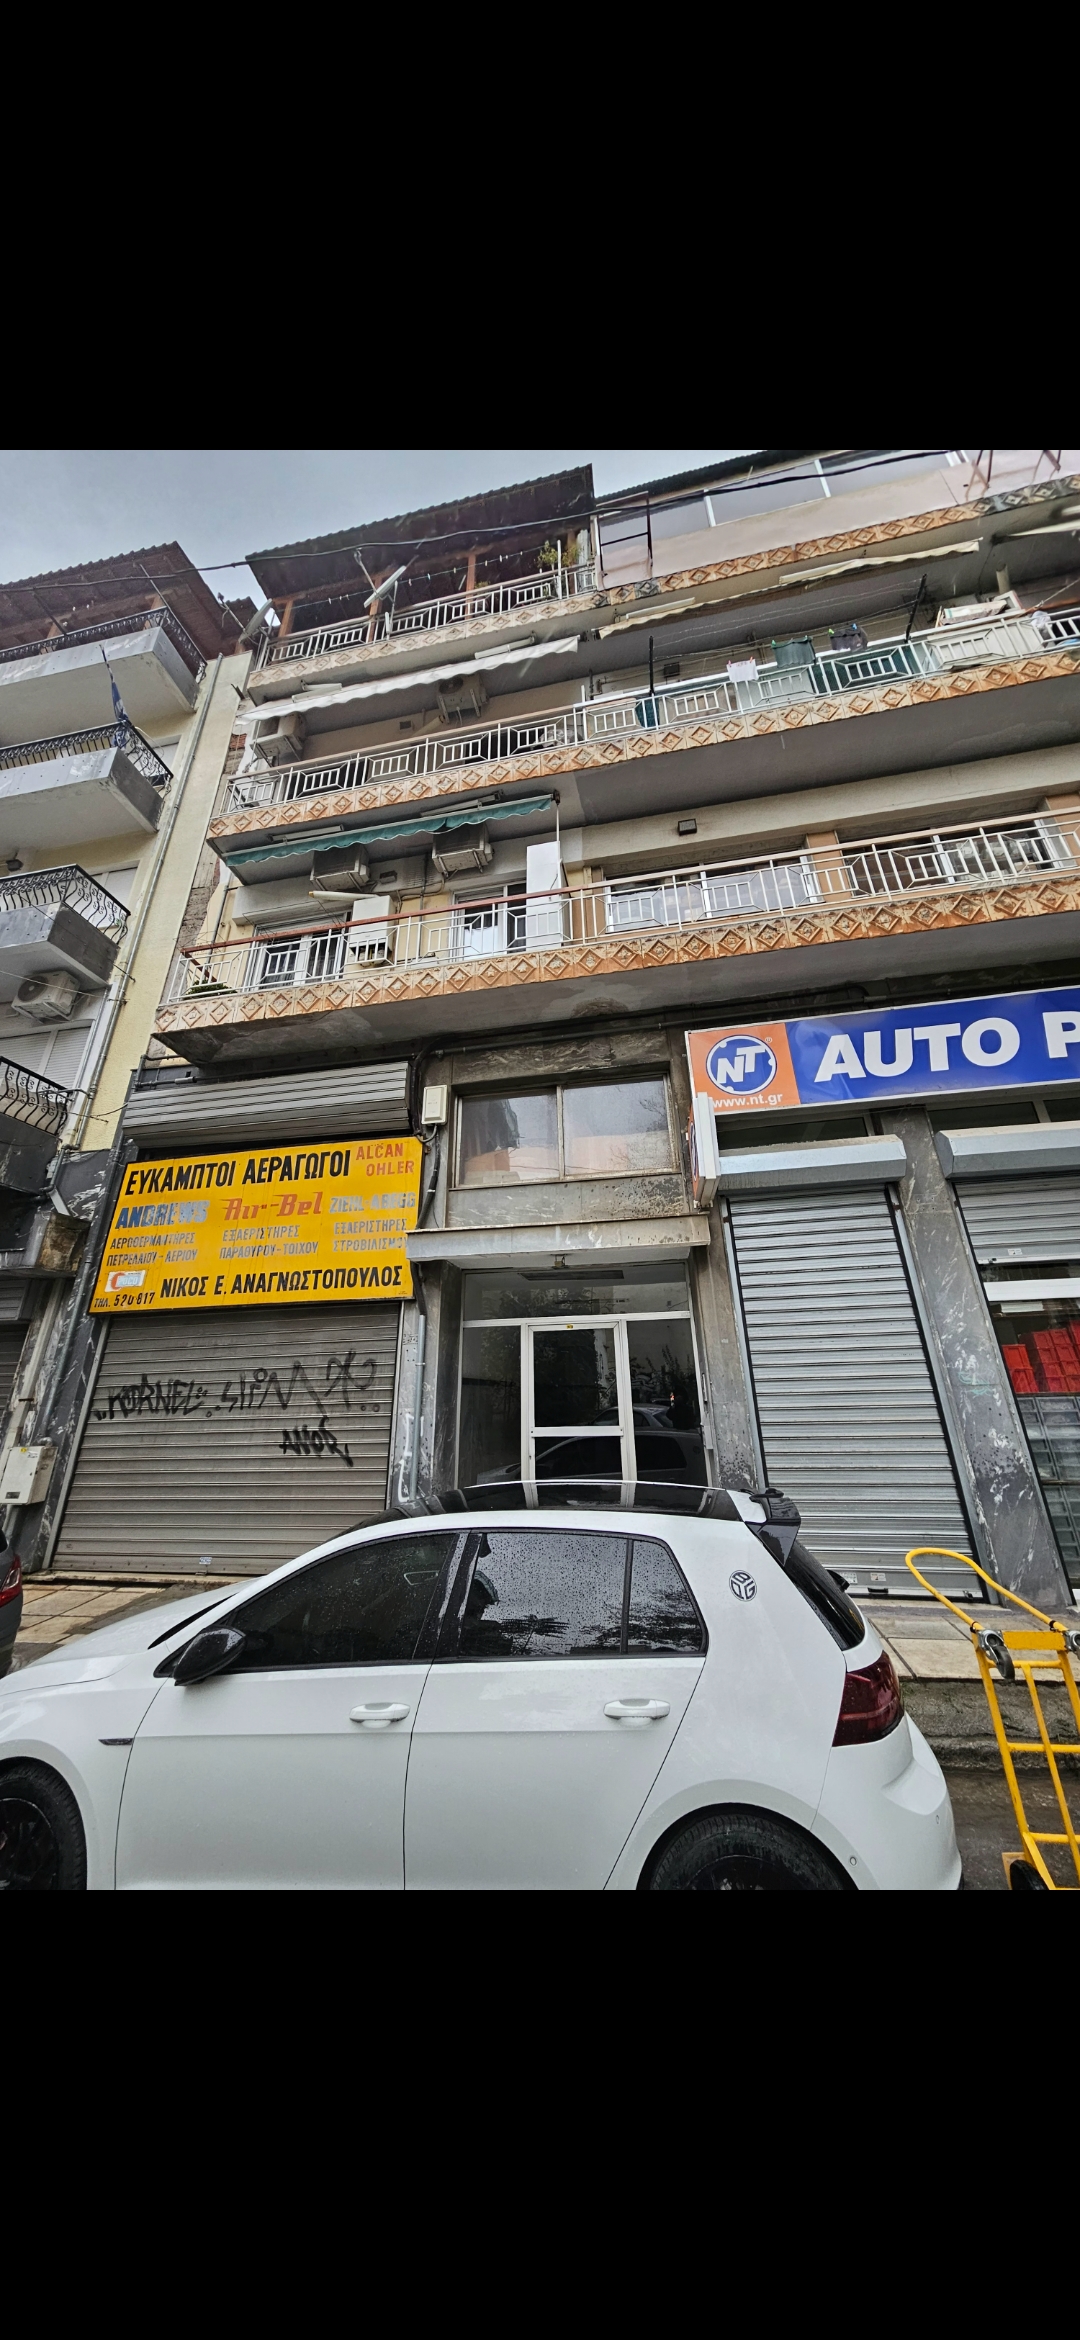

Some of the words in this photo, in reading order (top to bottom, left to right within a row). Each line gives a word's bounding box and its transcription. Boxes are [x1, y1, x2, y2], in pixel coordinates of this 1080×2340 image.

[717, 1045, 766, 1084] NT
[814, 1017, 1020, 1084] AUTO
[712, 1093, 783, 1109] www.nt.gr
[355, 1143, 404, 1160] ALCAN
[125, 1160, 236, 1196] ΕΥΚΑΜΠΤΟΙ
[242, 1150, 351, 1185] ΑΕΡΑΓΩΓΟΙ
[366, 1160, 414, 1177] OHLER
[115, 1200, 210, 1229] ANDREWS
[160, 1276, 209, 1299] ΝΙΚΟΣ
[230, 1265, 403, 1295] ΑΝΑΓΝΩΣΤΟΠΟΥΛΟΣ
